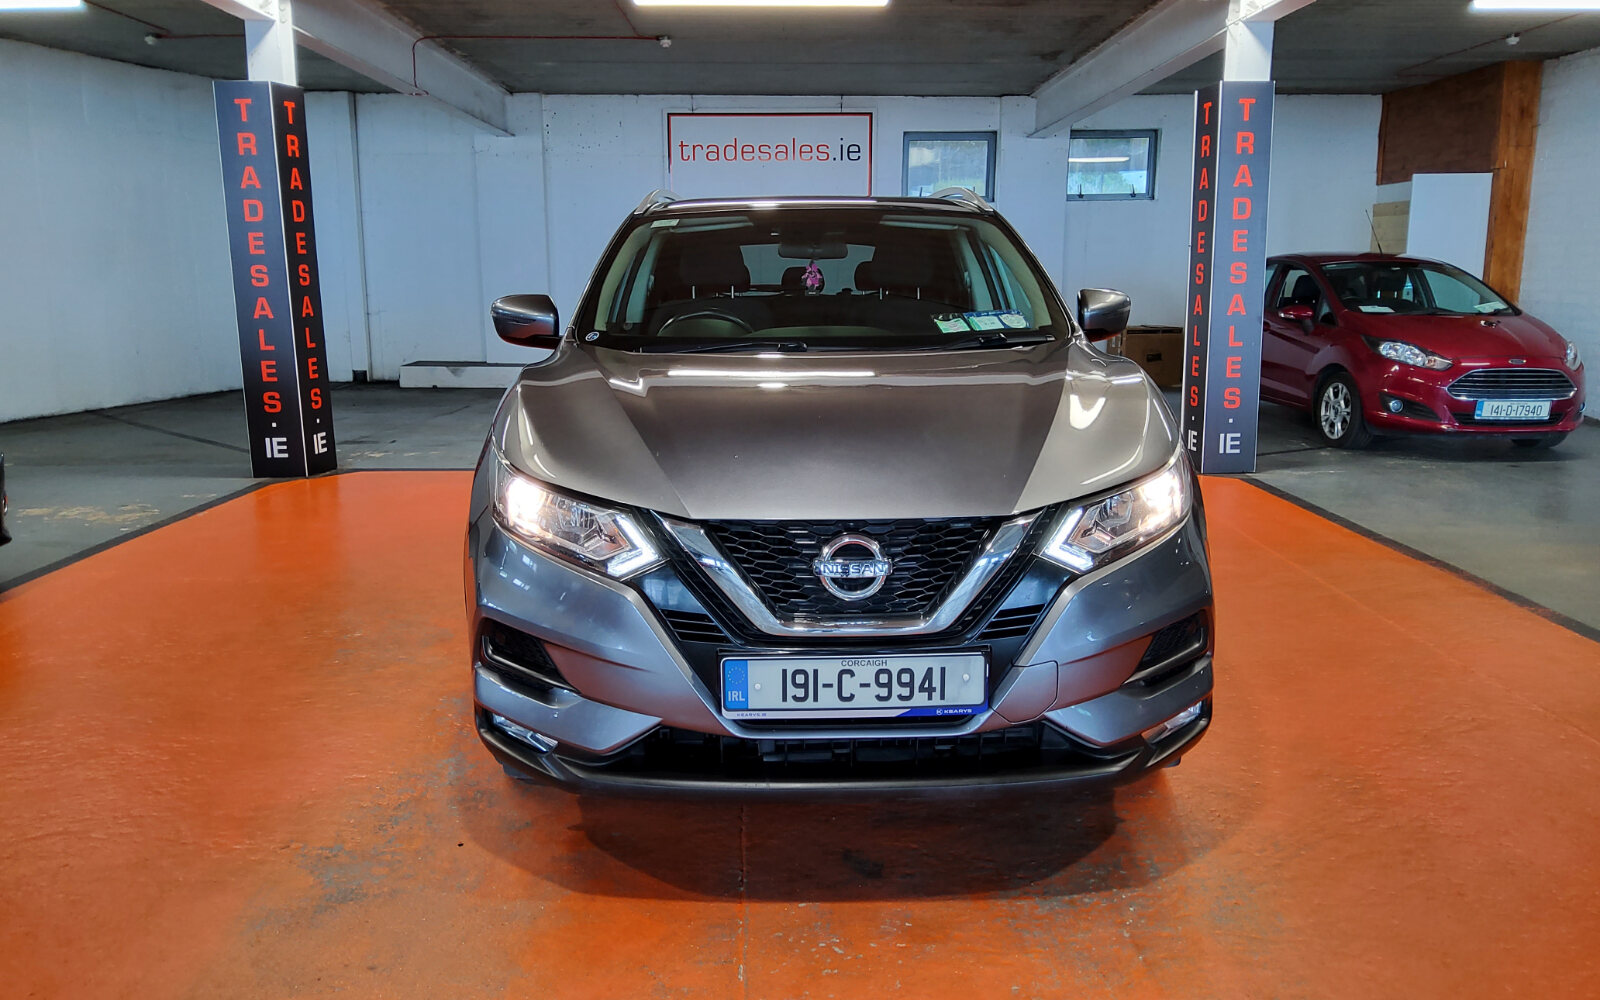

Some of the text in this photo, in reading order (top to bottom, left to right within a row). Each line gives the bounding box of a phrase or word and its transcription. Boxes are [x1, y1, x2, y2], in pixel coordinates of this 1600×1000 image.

[678, 137, 862, 162] tradesales.ie
[1490, 404, 1543, 416] 141-D-17940
[822, 563, 886, 575] NISSAN
[840, 659, 888, 667] CORCAIGH
[781, 666, 947, 703] 191-C-9941
[727, 690, 746, 702] IRL
